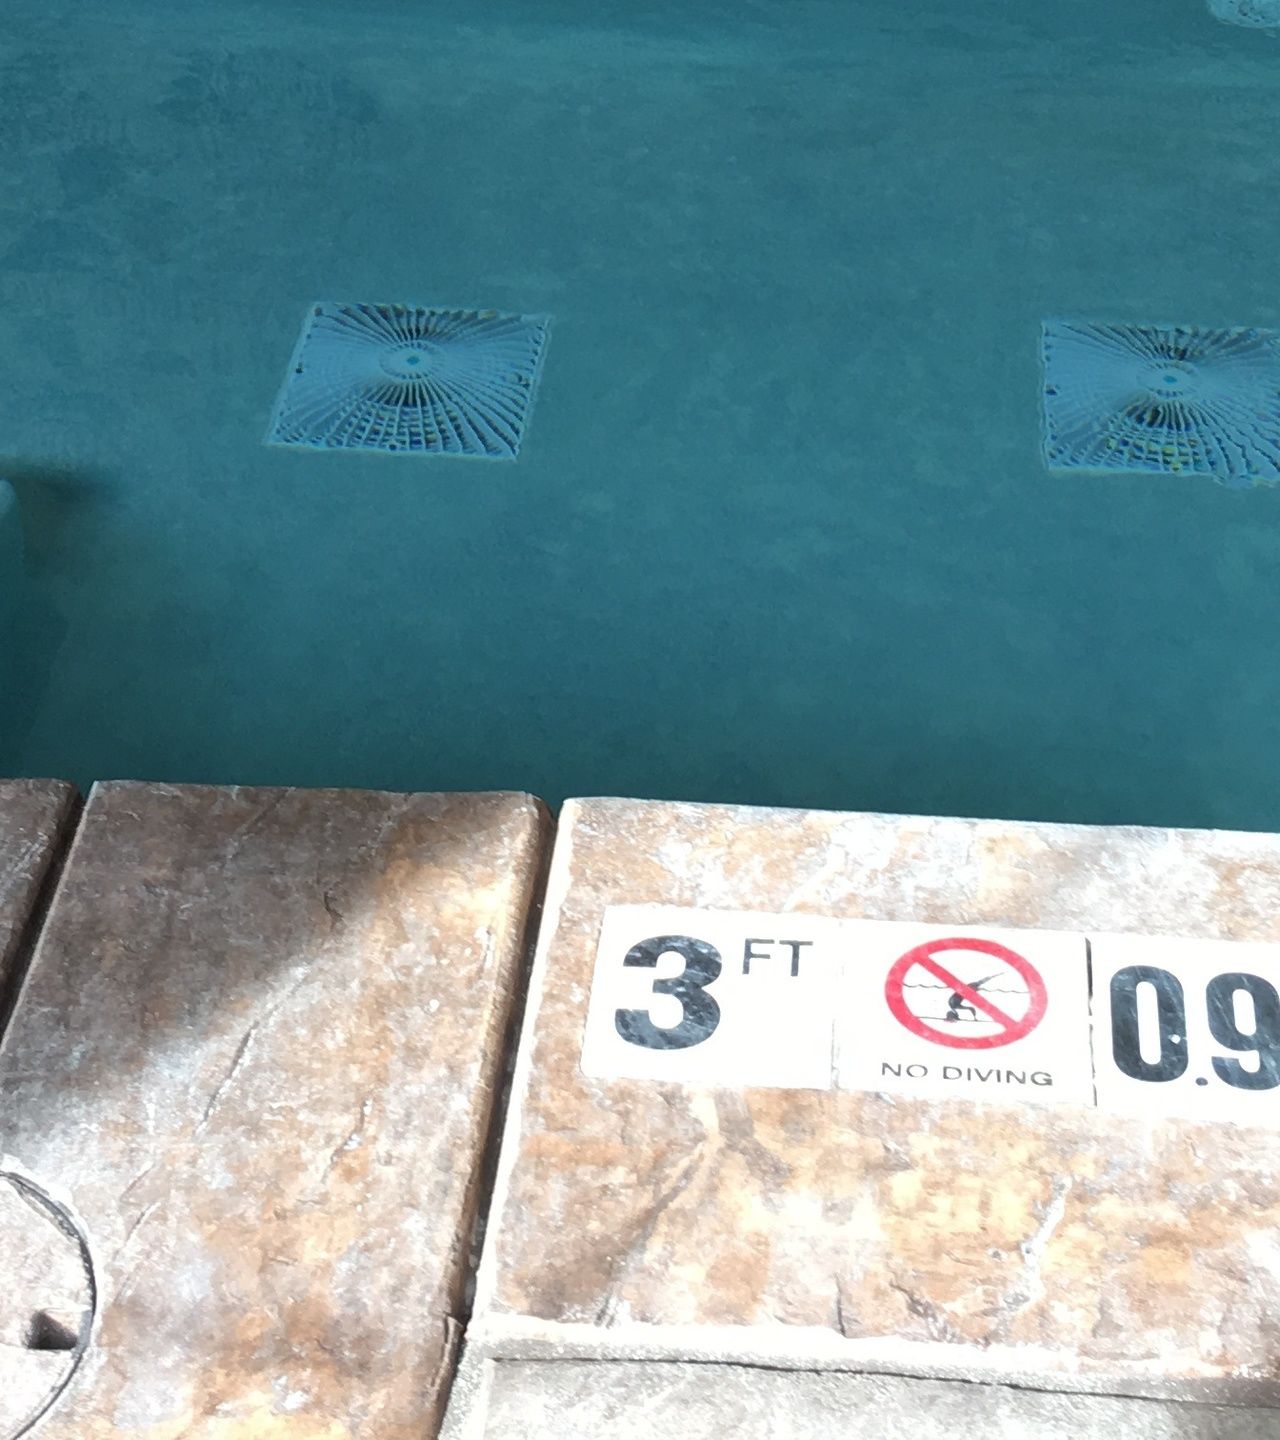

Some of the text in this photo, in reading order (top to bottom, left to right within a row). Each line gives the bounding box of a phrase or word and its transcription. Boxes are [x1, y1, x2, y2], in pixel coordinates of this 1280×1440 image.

[614, 935, 814, 1051] 3 FT
[881, 1062, 1054, 1087] NO DIVING
